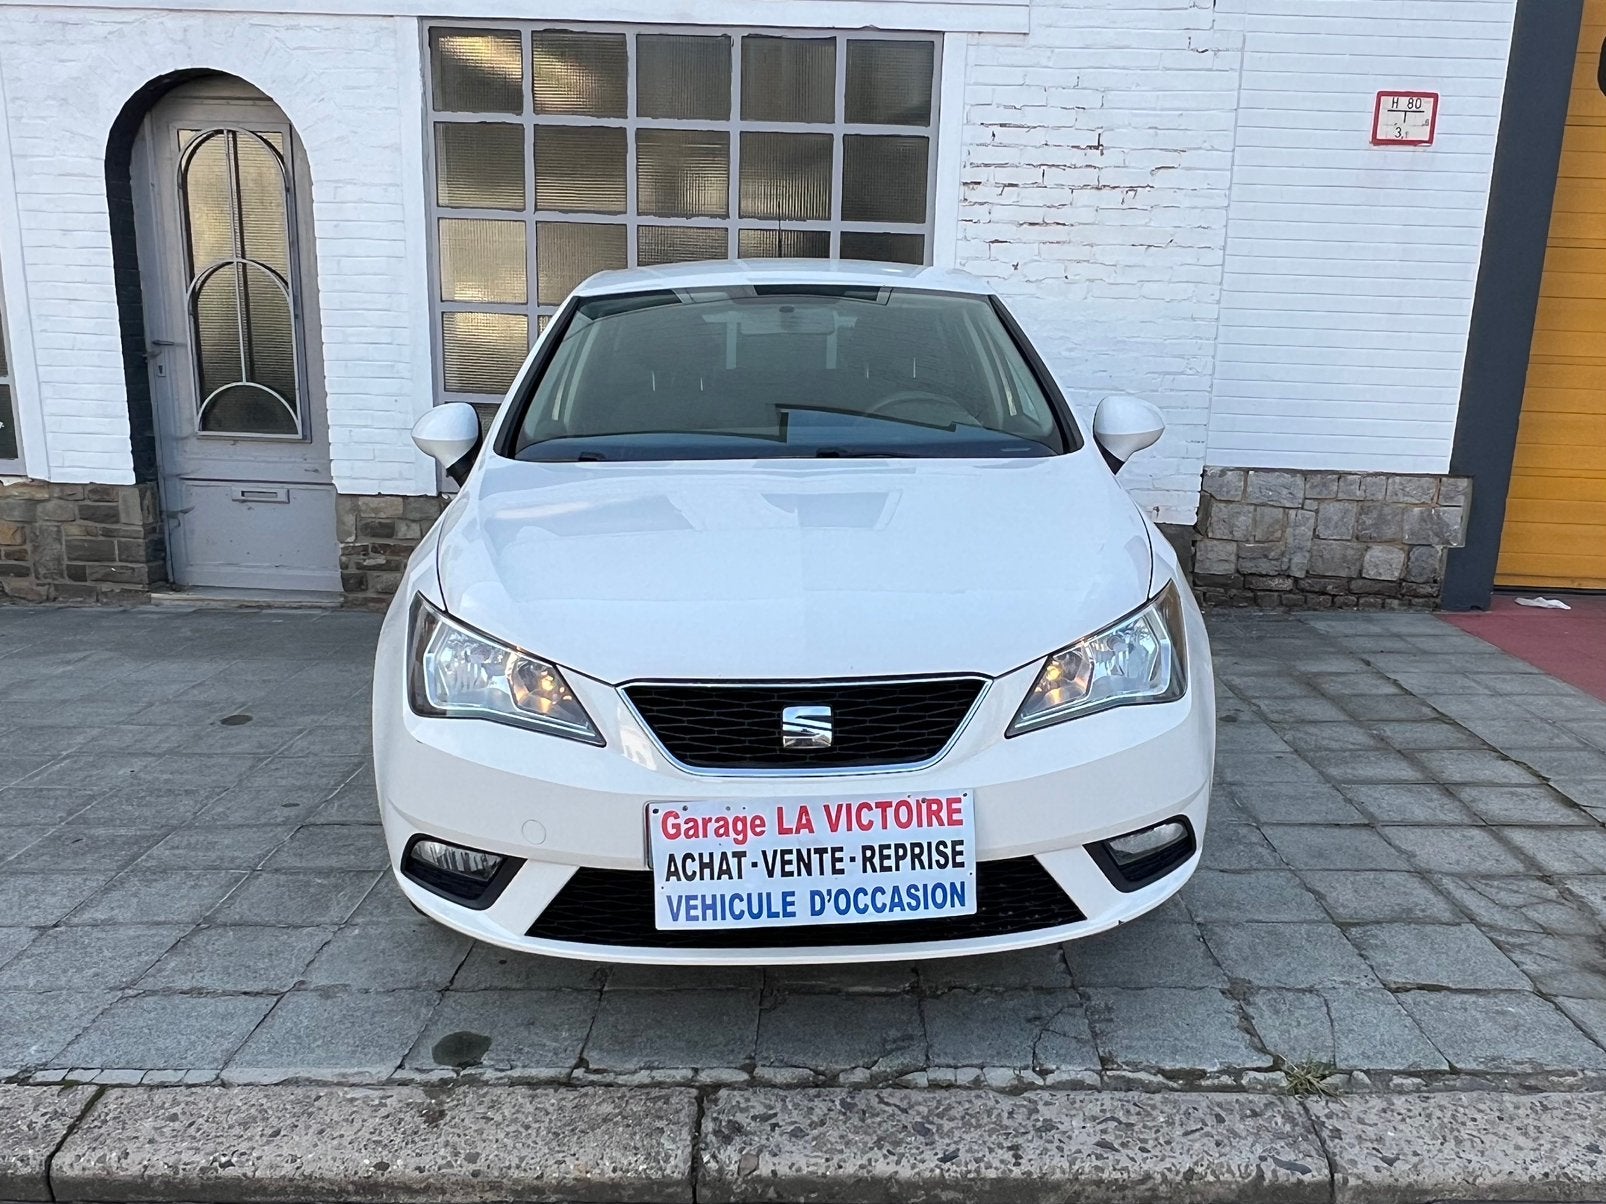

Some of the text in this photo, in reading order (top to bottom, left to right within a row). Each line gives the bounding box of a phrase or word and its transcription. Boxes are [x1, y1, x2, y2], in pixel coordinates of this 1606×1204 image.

[1391, 97, 1422, 109] H 80
[661, 797, 963, 845] Garage LA VICTOIRE
[666, 881, 966, 922] VEHICULE D'OCCASION
